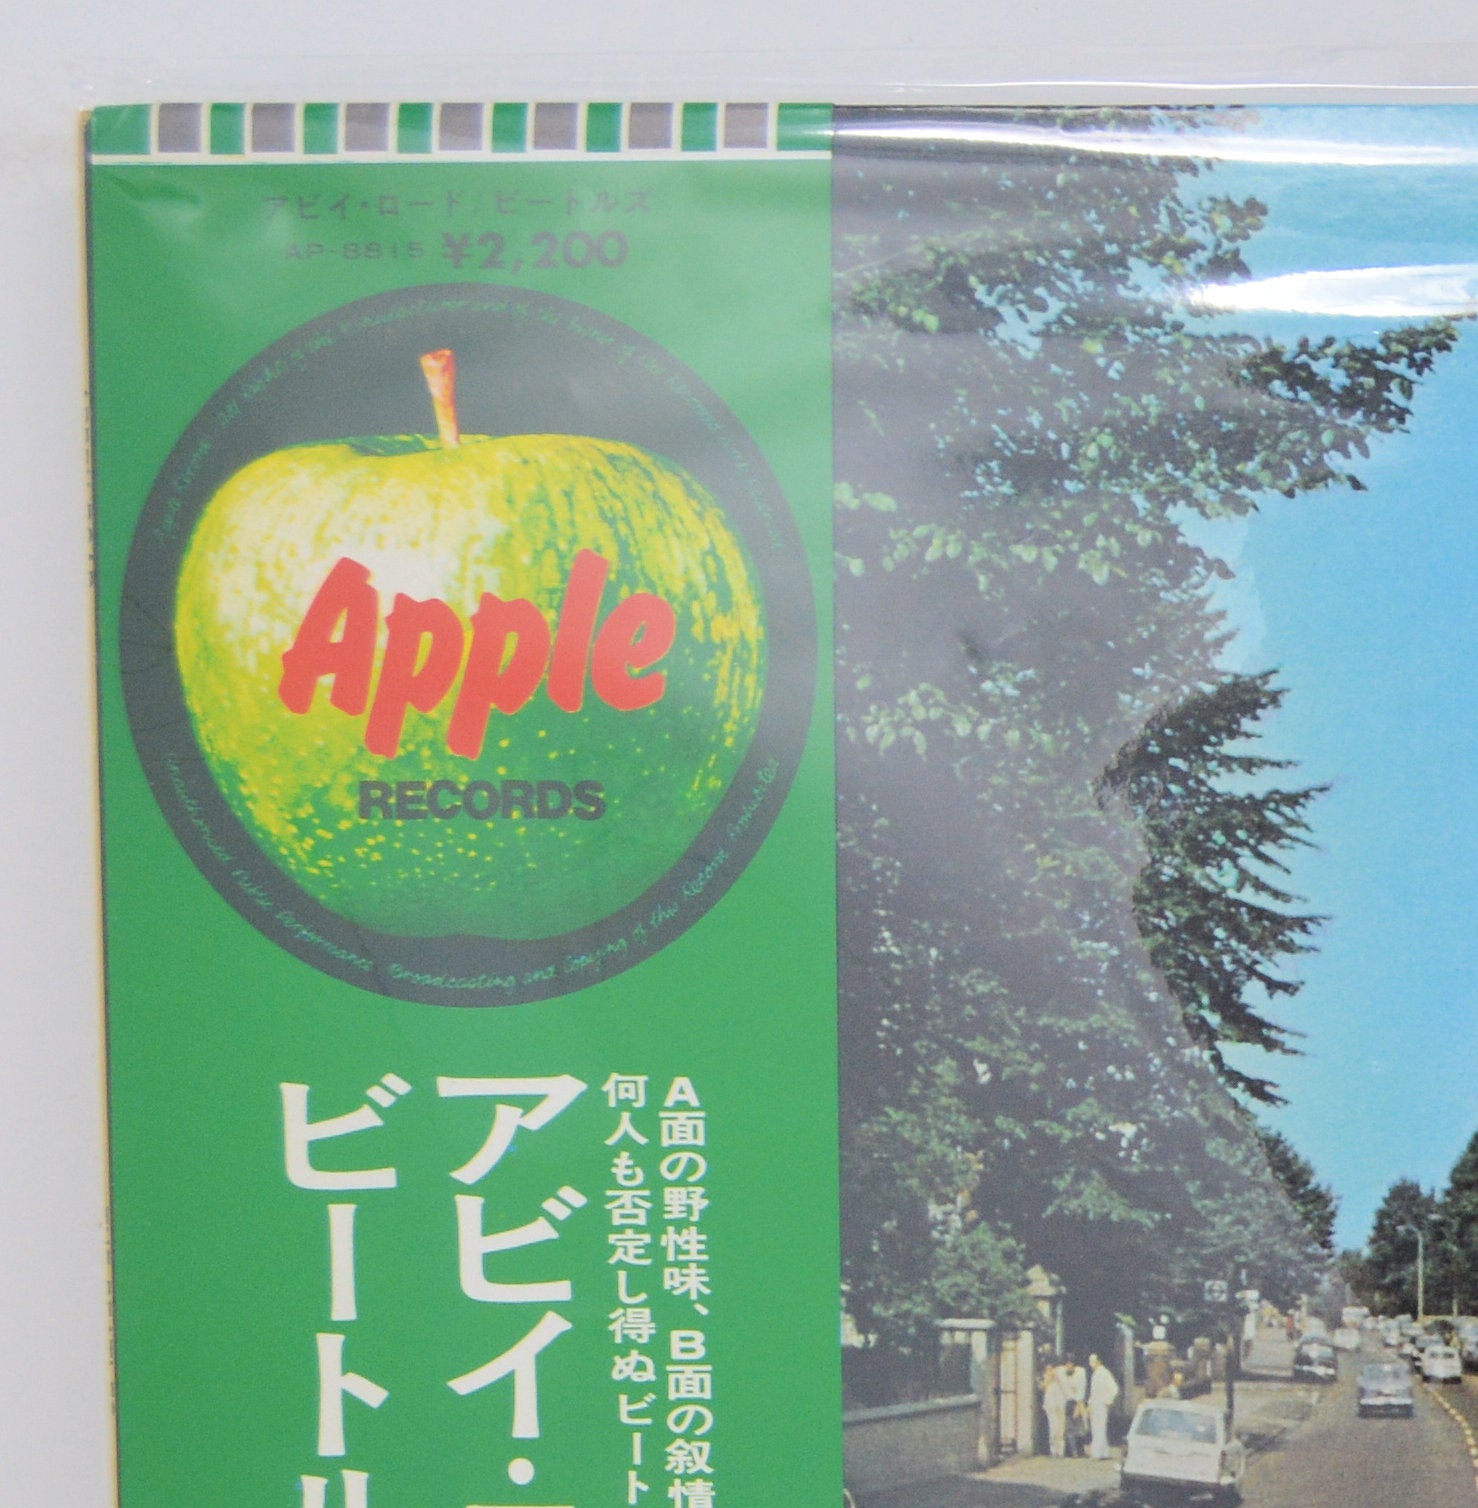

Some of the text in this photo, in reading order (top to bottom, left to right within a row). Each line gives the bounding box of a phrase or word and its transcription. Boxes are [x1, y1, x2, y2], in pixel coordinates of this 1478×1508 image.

[441, 230, 630, 275] ¥2,200
[280, 547, 678, 759] Apple
[358, 780, 608, 821] RECORDS
